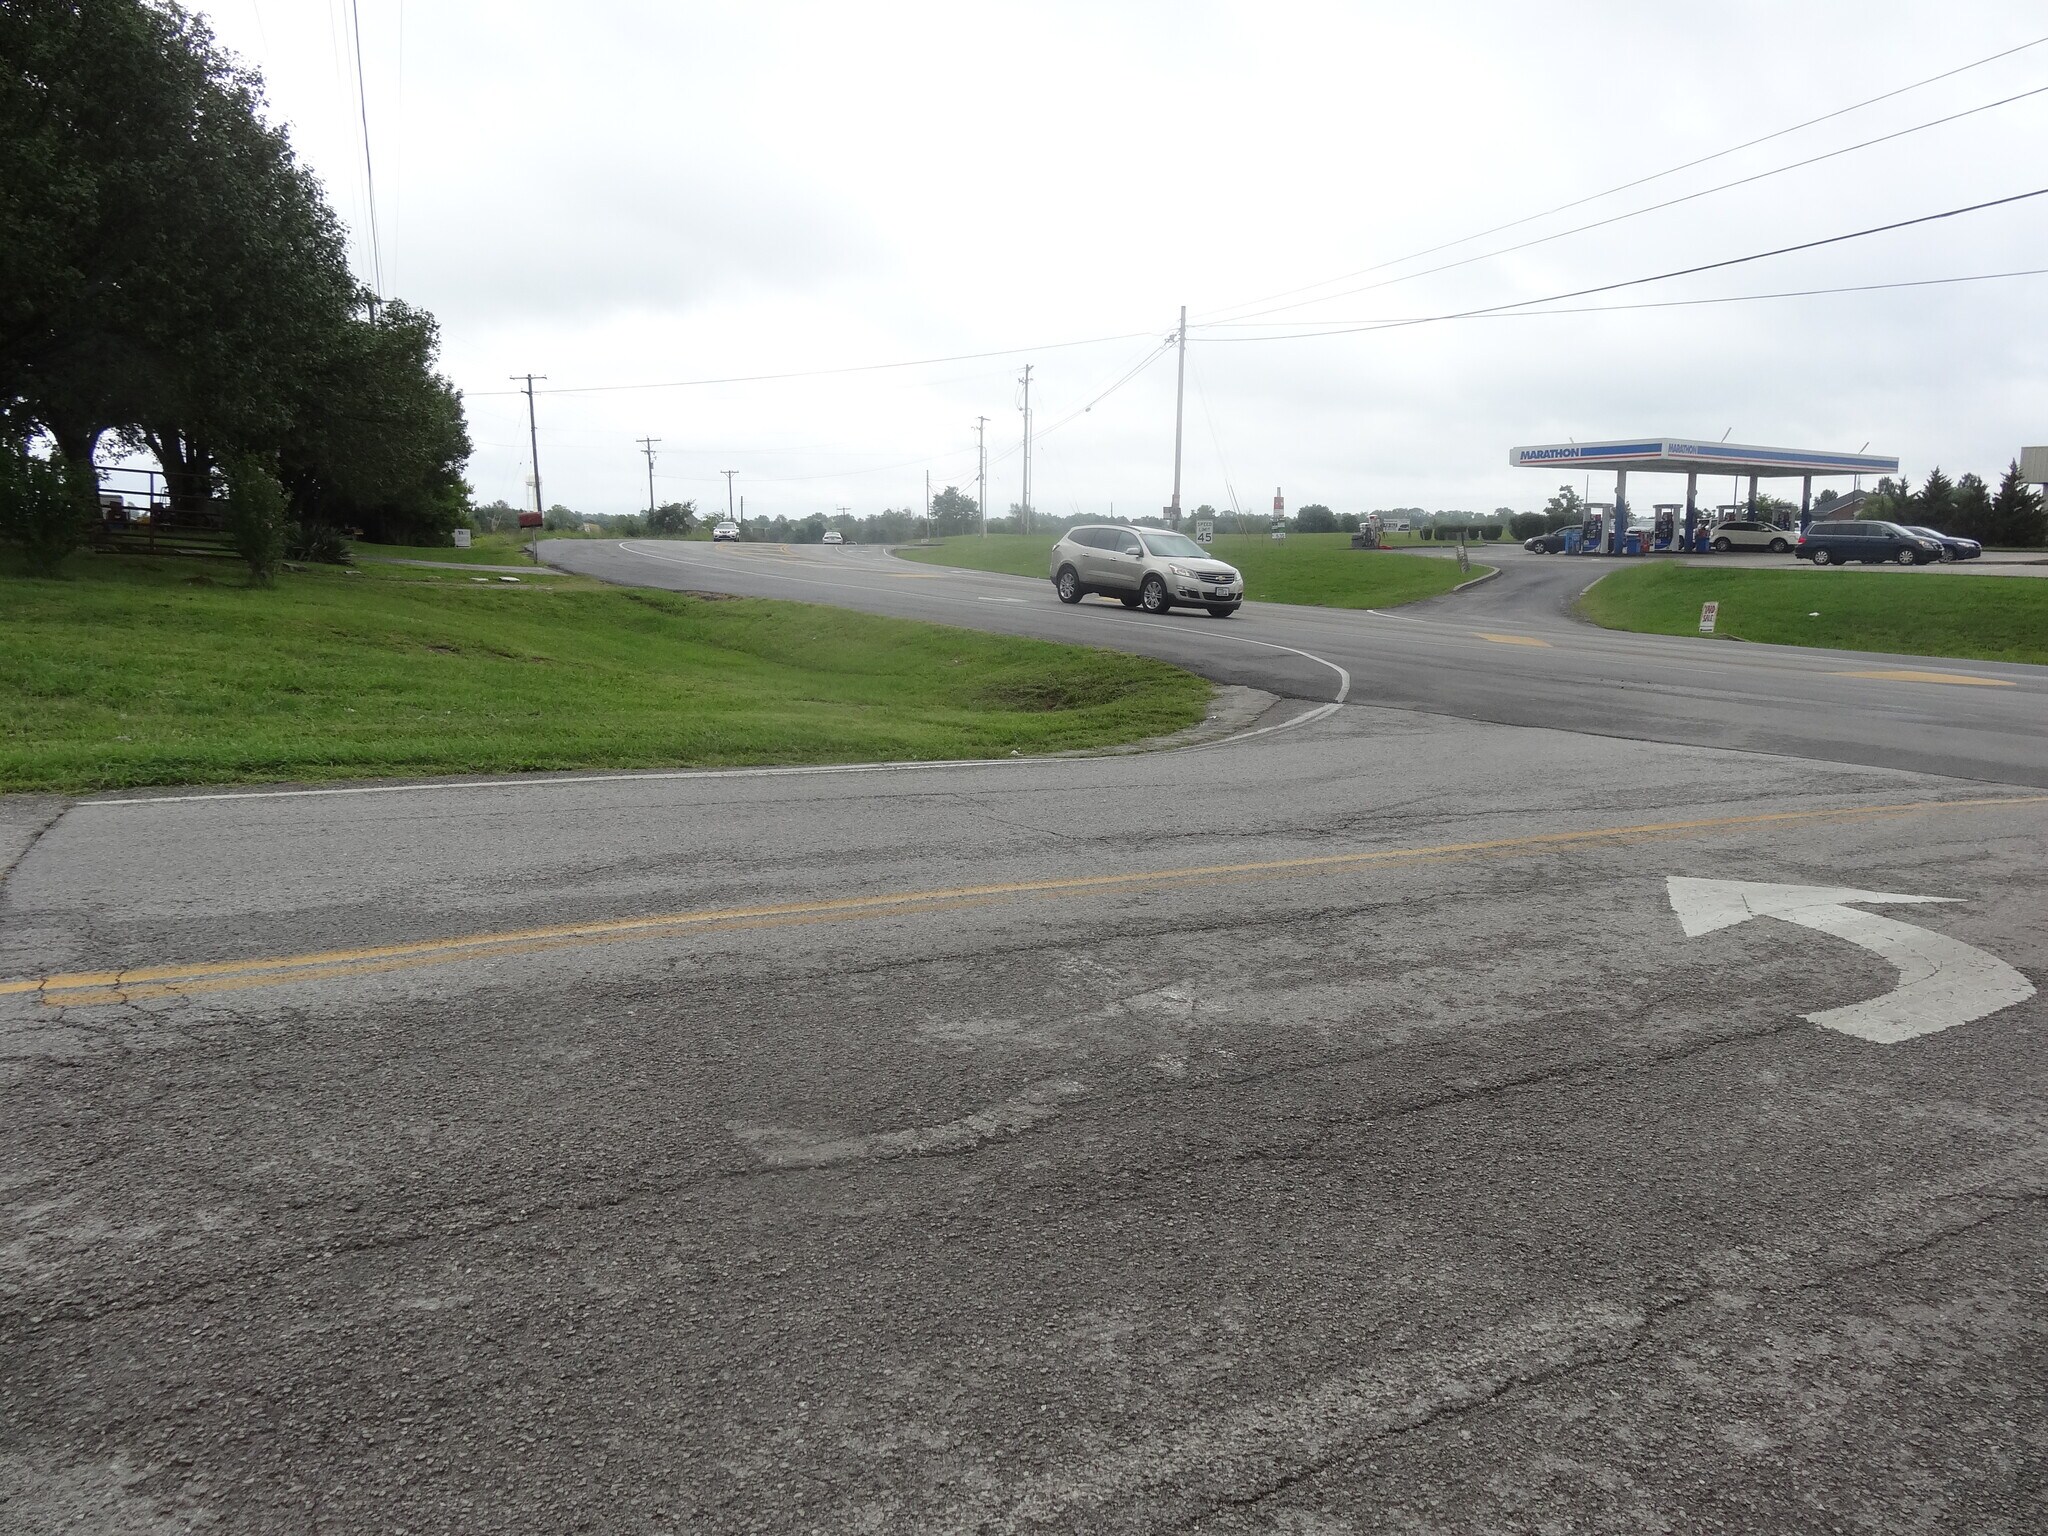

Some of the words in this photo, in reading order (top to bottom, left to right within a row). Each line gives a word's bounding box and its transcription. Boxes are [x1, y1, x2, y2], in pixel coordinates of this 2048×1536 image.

[1520, 448, 1580, 460] MARATHON
[1668, 443, 1697, 455] MARATHON
[1197, 532, 1212, 542] 45
